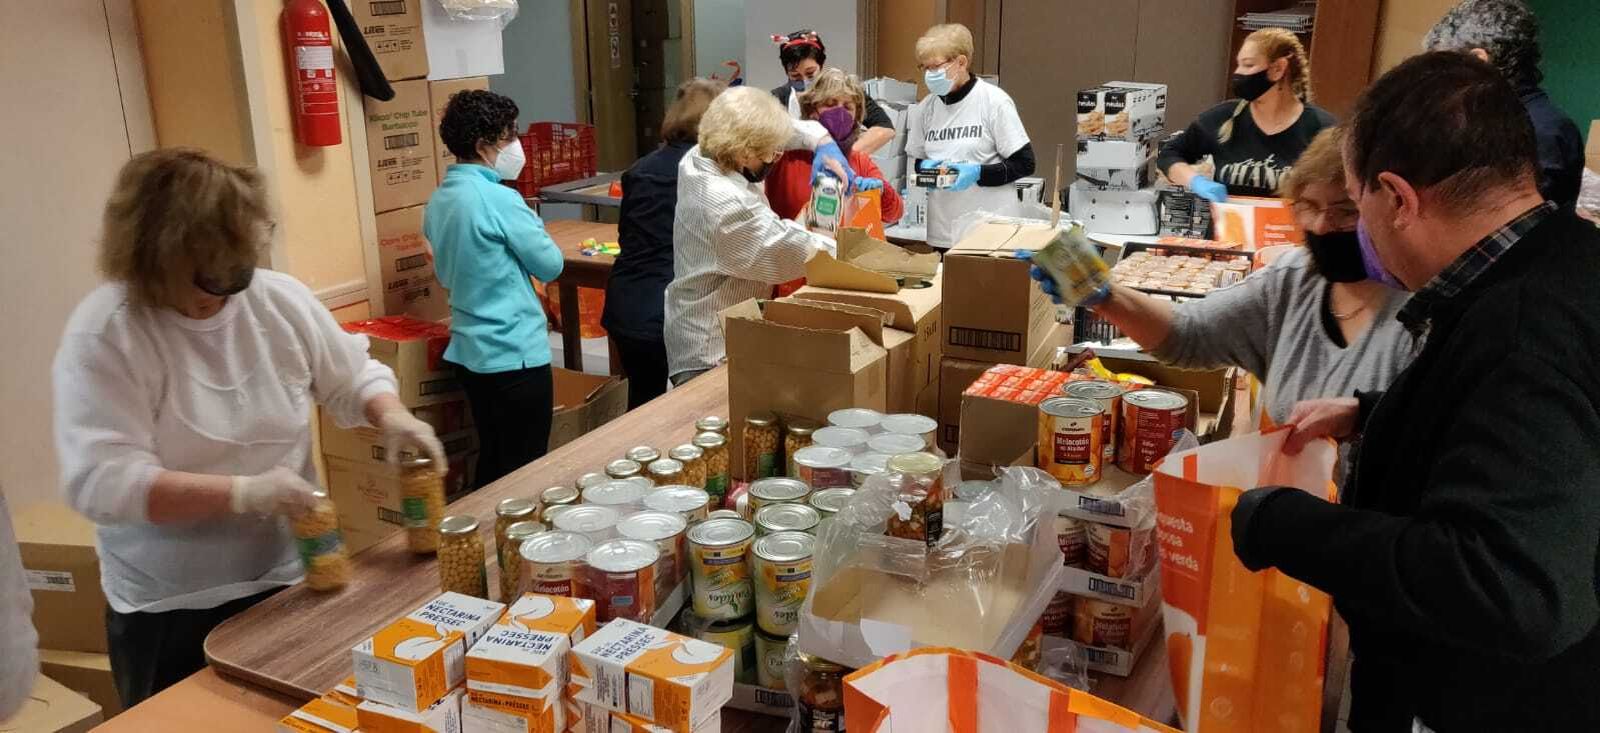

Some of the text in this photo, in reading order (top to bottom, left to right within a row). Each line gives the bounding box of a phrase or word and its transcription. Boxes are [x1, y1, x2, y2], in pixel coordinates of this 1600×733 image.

[426, 604, 481, 621] NECTARINA
[486, 635, 553, 650] NECTARINA
[599, 626, 649, 658] NECTARINA
